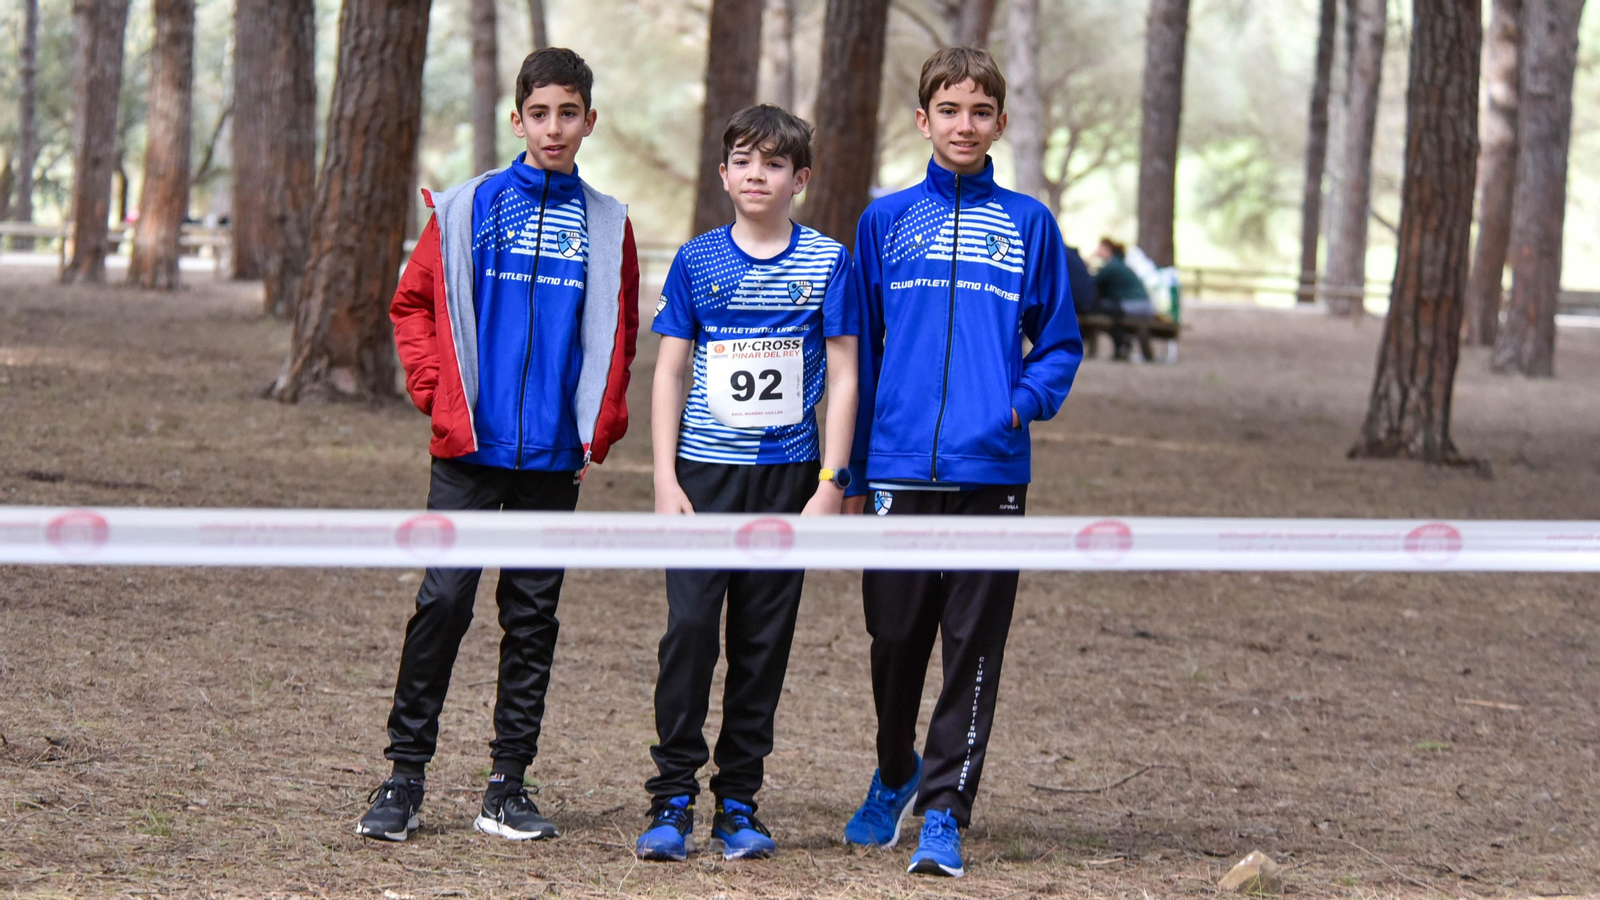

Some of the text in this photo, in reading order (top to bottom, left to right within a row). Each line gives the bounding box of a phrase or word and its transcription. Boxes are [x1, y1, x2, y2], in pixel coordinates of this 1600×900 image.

[890, 279, 914, 291] CLUB
[984, 284, 1020, 302] LINENSE
[720, 326, 774, 334] ATLETISMO
[731, 352, 762, 360] PINAR
[763, 351, 781, 359] DEL
[782, 349, 801, 358] REY
[730, 368, 784, 402] 92
[976, 656, 985, 683] CLUB
